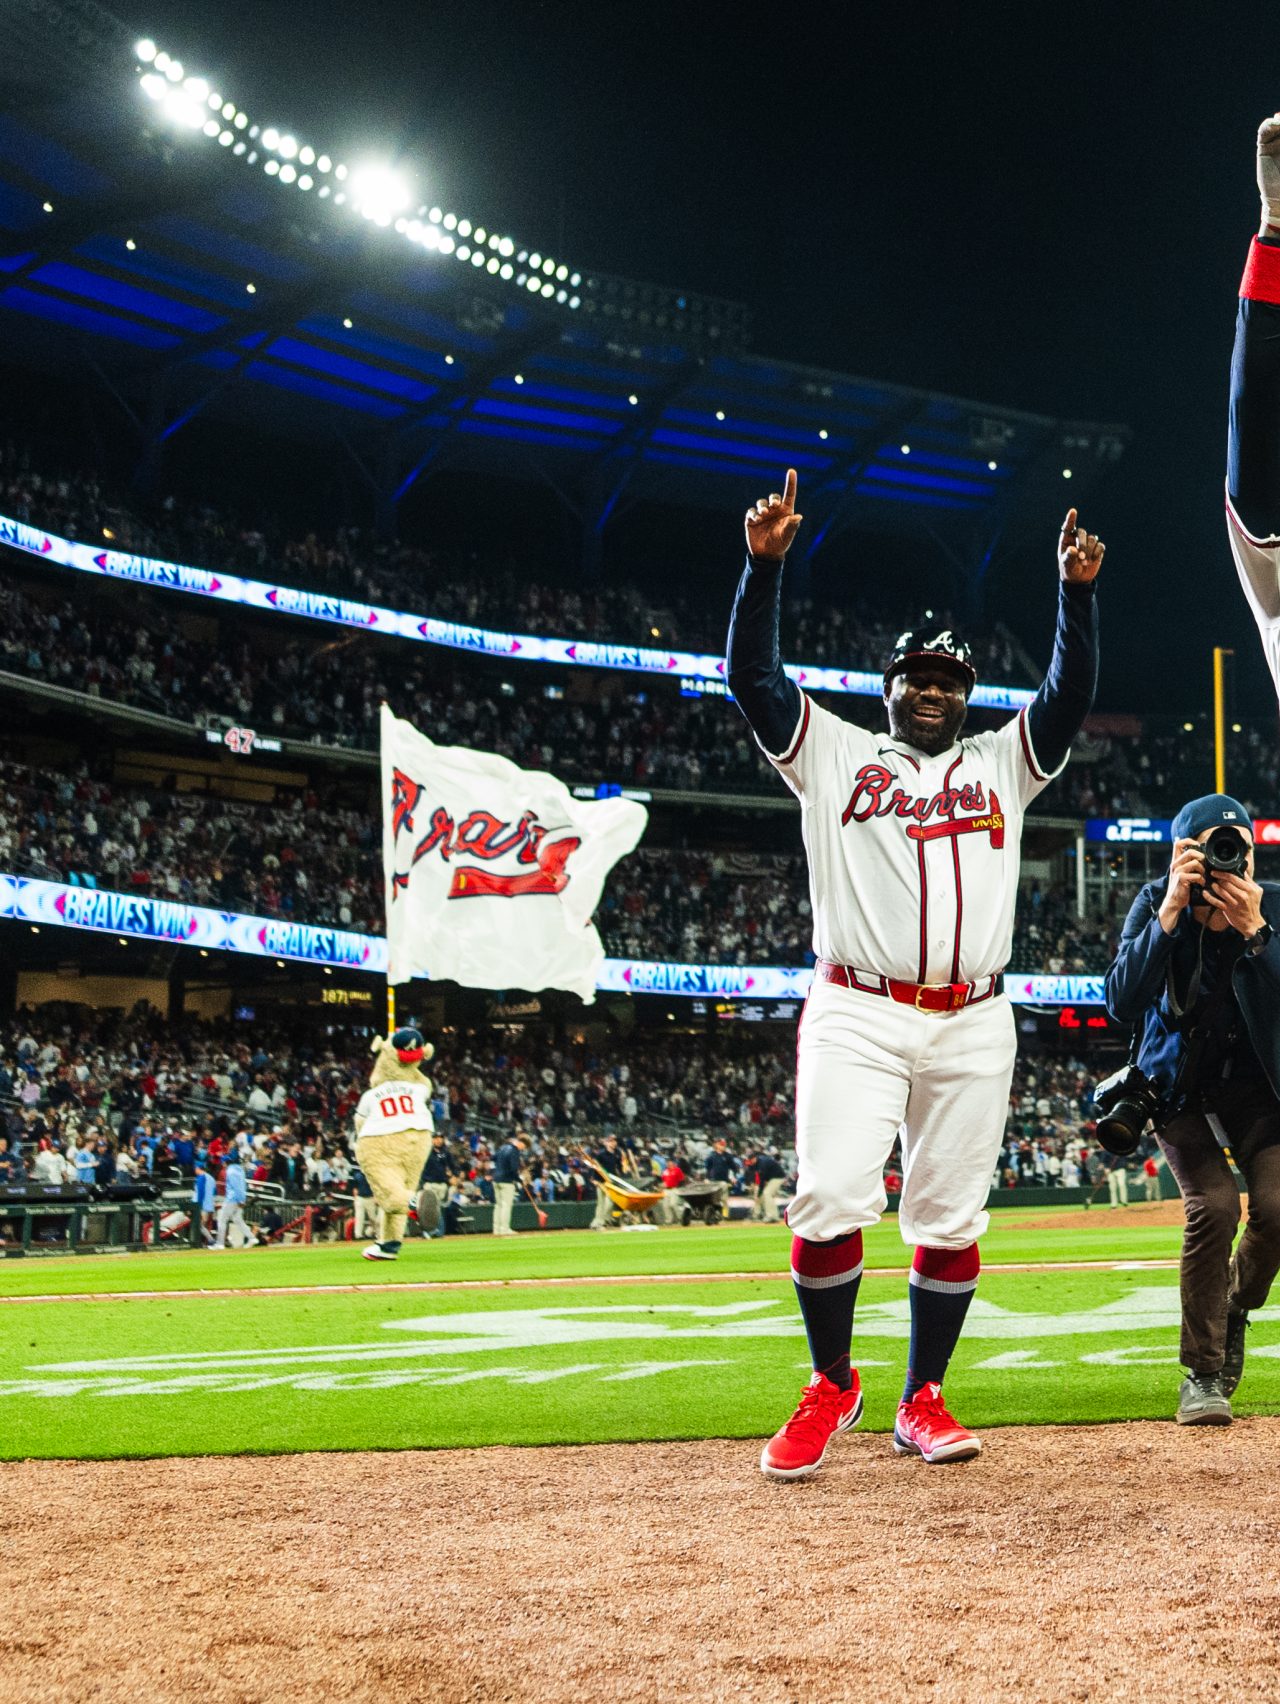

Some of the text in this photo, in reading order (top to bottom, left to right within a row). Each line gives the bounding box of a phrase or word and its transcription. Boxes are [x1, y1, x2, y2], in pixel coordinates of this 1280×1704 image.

[105, 551, 213, 591] BRAVES WIN
[276, 589, 341, 620] BRAVES
[427, 622, 485, 648] BRAVES
[923, 631, 955, 653] A
[575, 641, 639, 667] BRAVES
[224, 727, 256, 755] 47
[842, 764, 986, 827] Braves
[65, 887, 191, 939] BRAVES WIN
[264, 922, 366, 965] BRAVES WIN
[631, 962, 748, 993] BRAVES WIN
[322, 989, 349, 1005] 1871
[379, 1095, 415, 1118] 00
[0, 1360, 735, 1397] REIGHT
